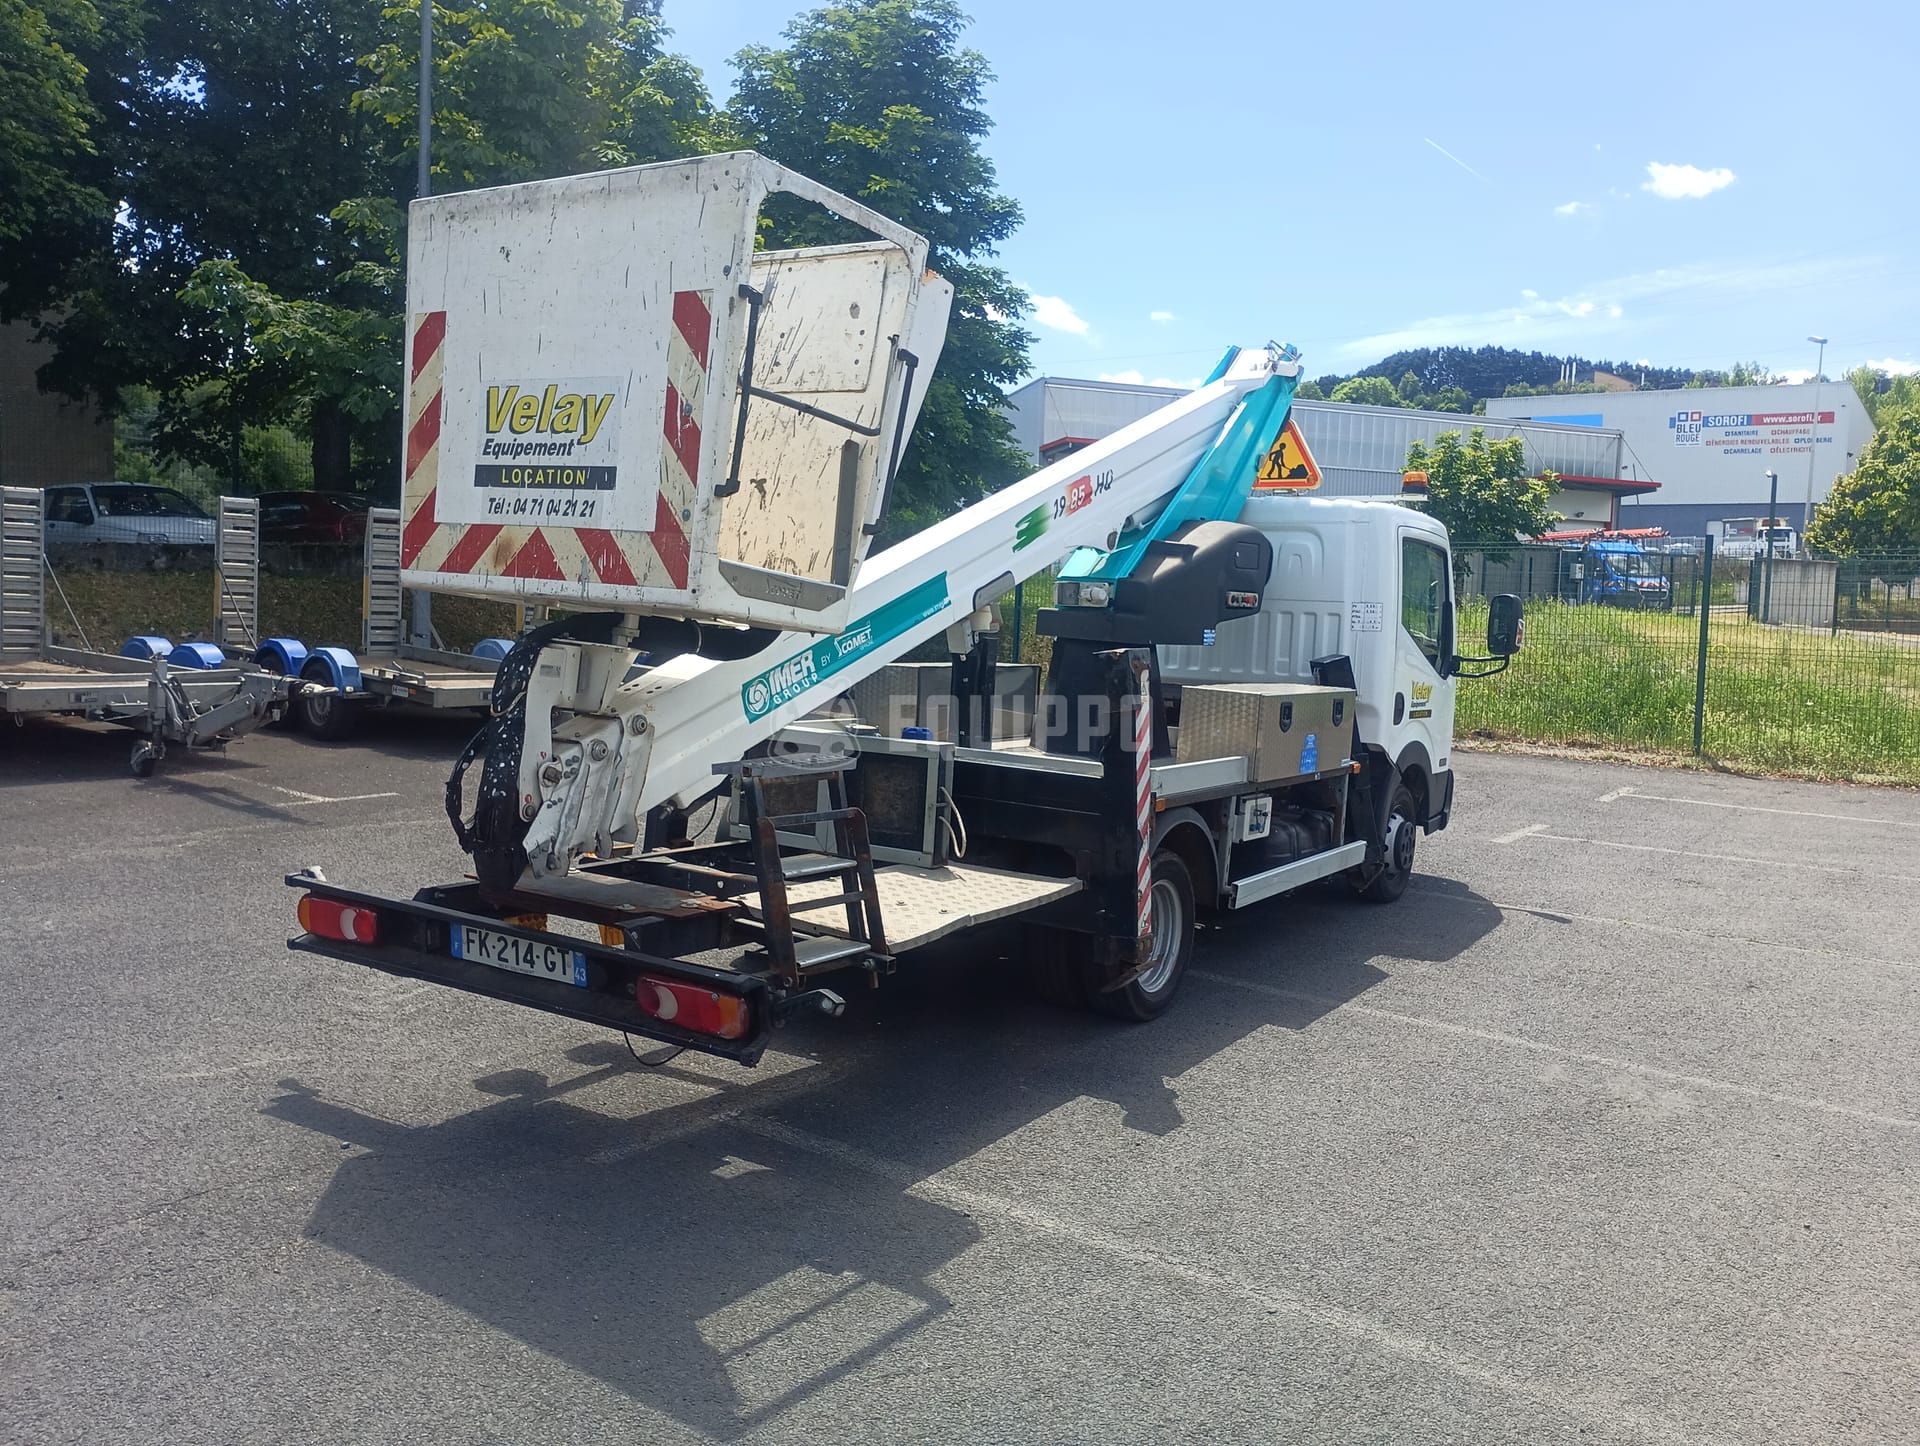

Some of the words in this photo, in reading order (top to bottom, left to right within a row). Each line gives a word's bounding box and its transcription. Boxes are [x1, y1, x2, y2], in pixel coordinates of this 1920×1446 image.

[486, 384, 615, 445] Velay
[1708, 415, 1748, 427] SOROFI
[1763, 413, 1822, 423] www.sorofi.r
[1675, 434, 1700, 443] ROUGE
[1676, 423, 1701, 434] BLEU
[482, 438, 575, 460] Equipement
[502, 468, 586, 485] LOCATION
[513, 498, 527, 515] 04
[530, 499, 543, 516] 71
[546, 499, 561, 516] 04
[562, 499, 577, 517] 21
[579, 500, 596, 518] 21
[769, 650, 816, 695] IMER
[821, 653, 832, 667] BY
[773, 673, 818, 705] GROUP
[1410, 680, 1433, 703] Velay
[465, 927, 570, 976] FK-214-GT
[574, 967, 587, 981] 43
